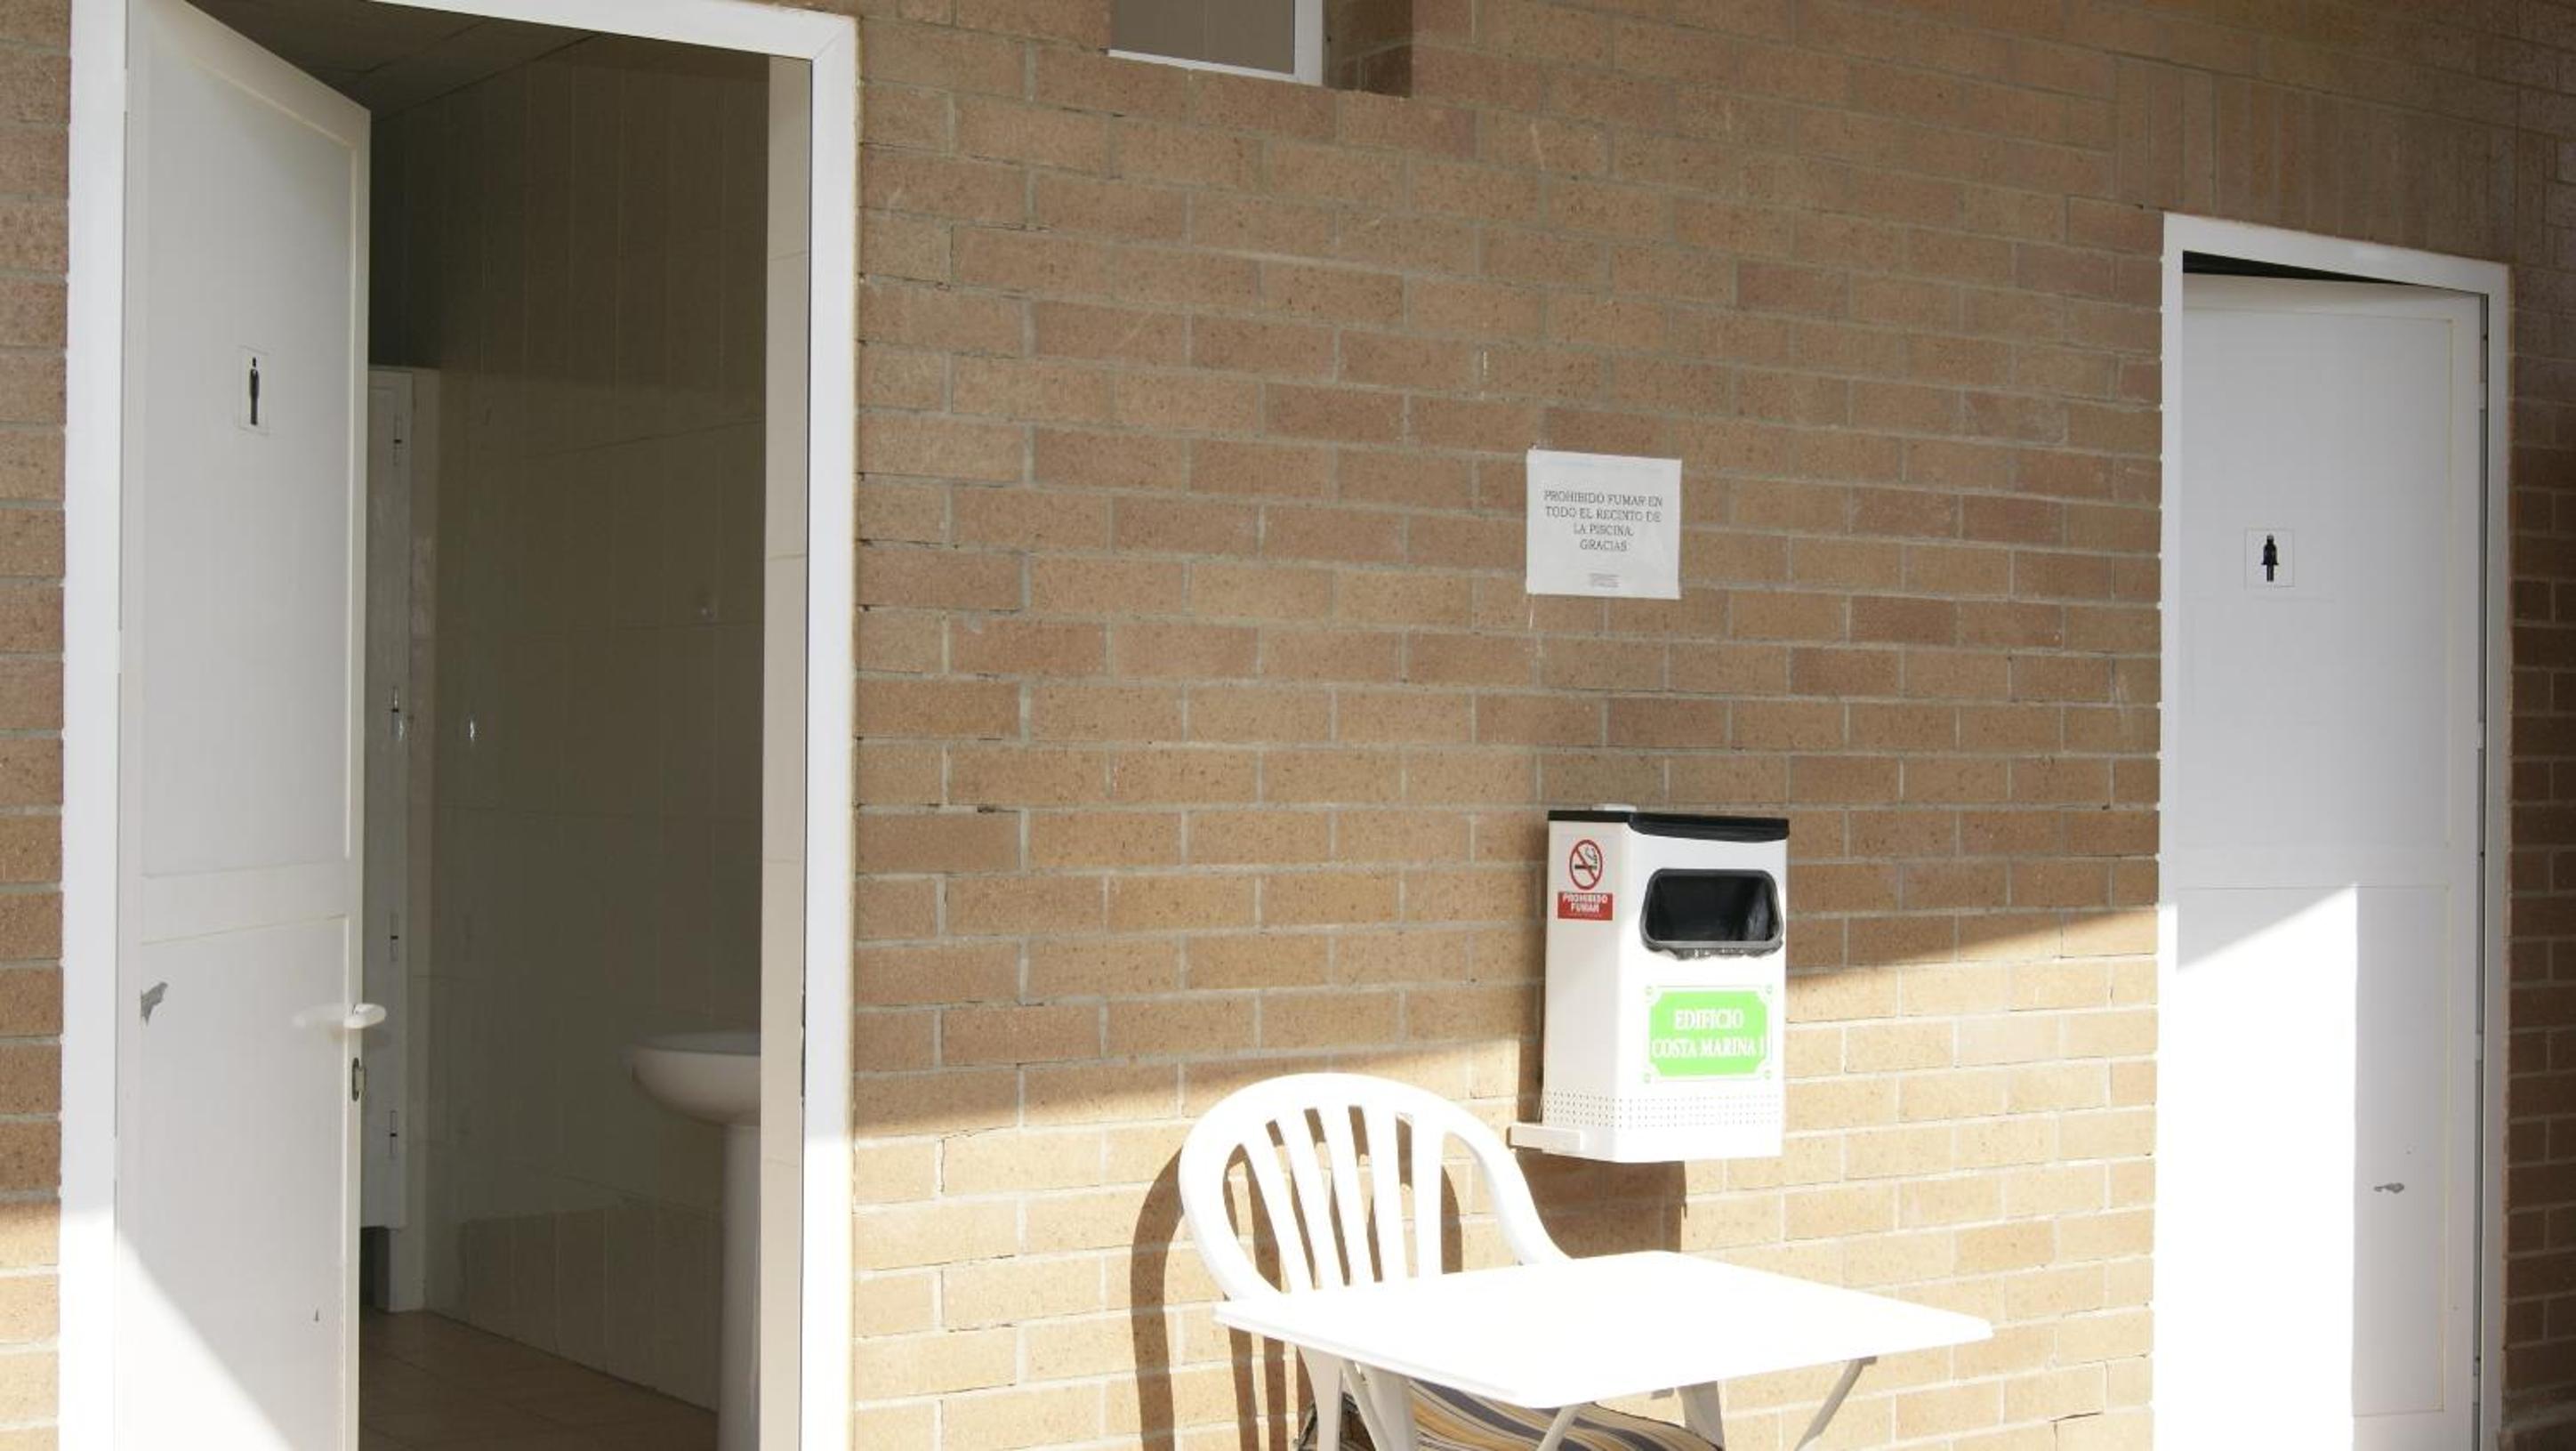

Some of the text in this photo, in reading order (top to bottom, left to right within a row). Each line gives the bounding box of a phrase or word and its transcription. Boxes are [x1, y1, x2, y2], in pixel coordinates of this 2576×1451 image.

[1543, 489, 1662, 507] PROHIBIDO FUMAR EN
[1546, 505, 1662, 522] TODO EL RECINTO DE
[1574, 522, 1586, 534] LA
[1580, 538, 1628, 552] GRACIAS
[1675, 1009, 1744, 1030] EDIFICIO
[1651, 1037, 1697, 1059] COSTA
[1699, 1036, 1757, 1059] MARINA
